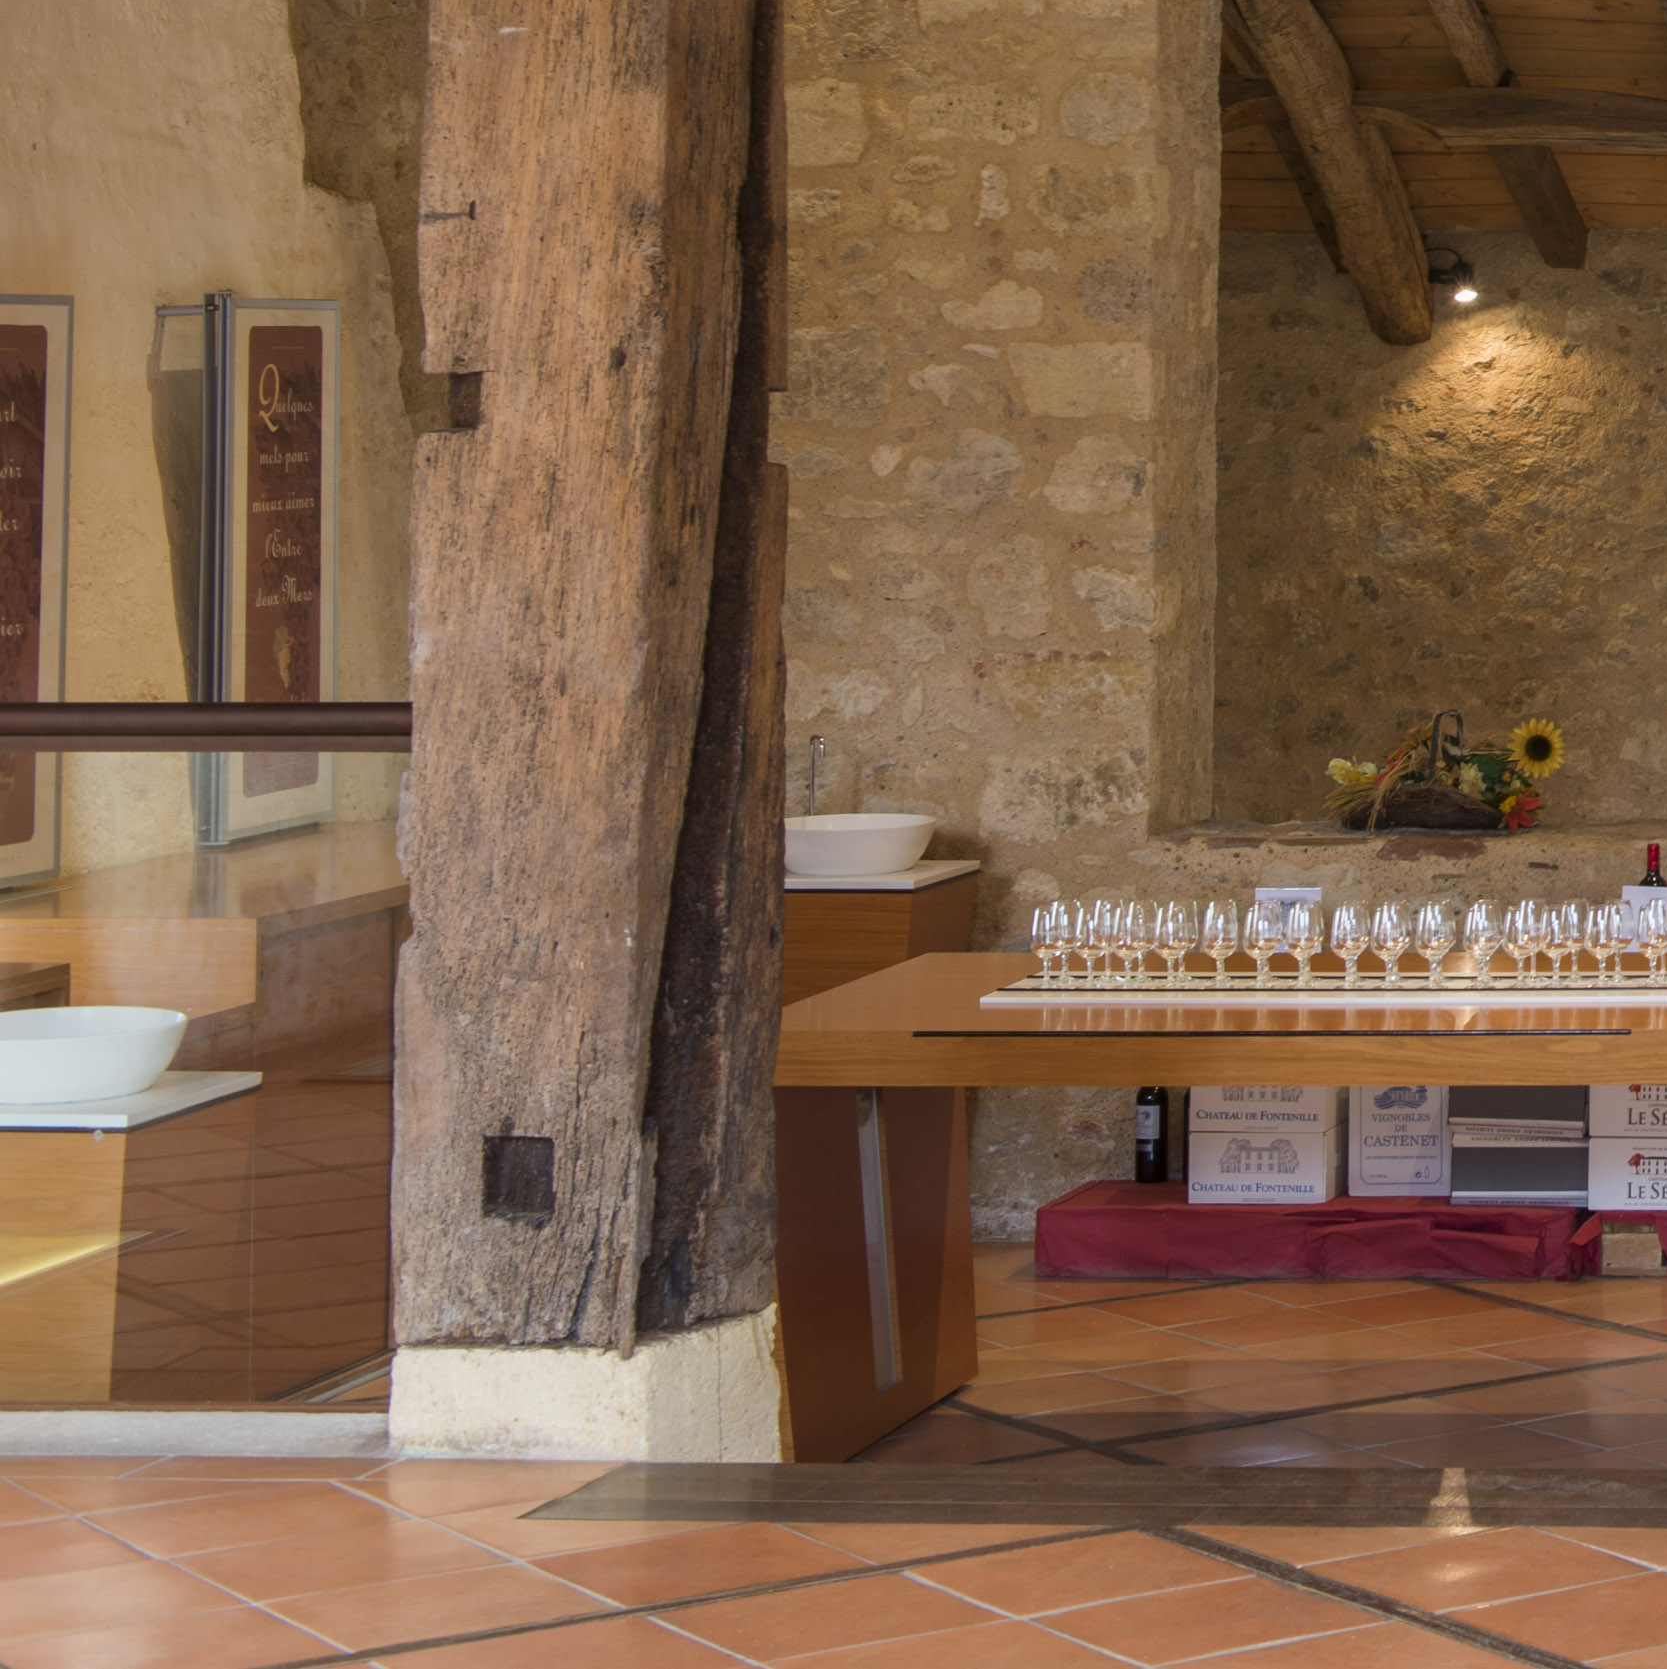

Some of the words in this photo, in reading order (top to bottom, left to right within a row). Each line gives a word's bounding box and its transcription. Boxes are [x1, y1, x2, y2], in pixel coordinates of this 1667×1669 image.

[259, 364, 313, 432] Quelques
[260, 447, 283, 465] mets
[285, 451, 309, 473] pour
[252, 495, 283, 513] mieux
[286, 492, 315, 510] aimer
[265, 529, 302, 559] l'Entre
[256, 588, 279, 608] deux
[281, 575, 312, 605] Mers
[1196, 1110, 1242, 1120] CHATEAU
[1245, 1112, 1258, 1120] DE
[1260, 1111, 1319, 1122] FONTENILLE
[1372, 1113, 1430, 1122] VIGNOBLES
[1627, 1108, 1646, 1125] LE
[1395, 1124, 1408, 1132] DE
[1364, 1135, 1439, 1147] CASTENET
[1192, 1182, 1238, 1192] CHATEAU
[1241, 1184, 1253, 1192] DE
[1255, 1183, 1315, 1193] FONTENILLE
[1627, 1183, 1646, 1199] LE
